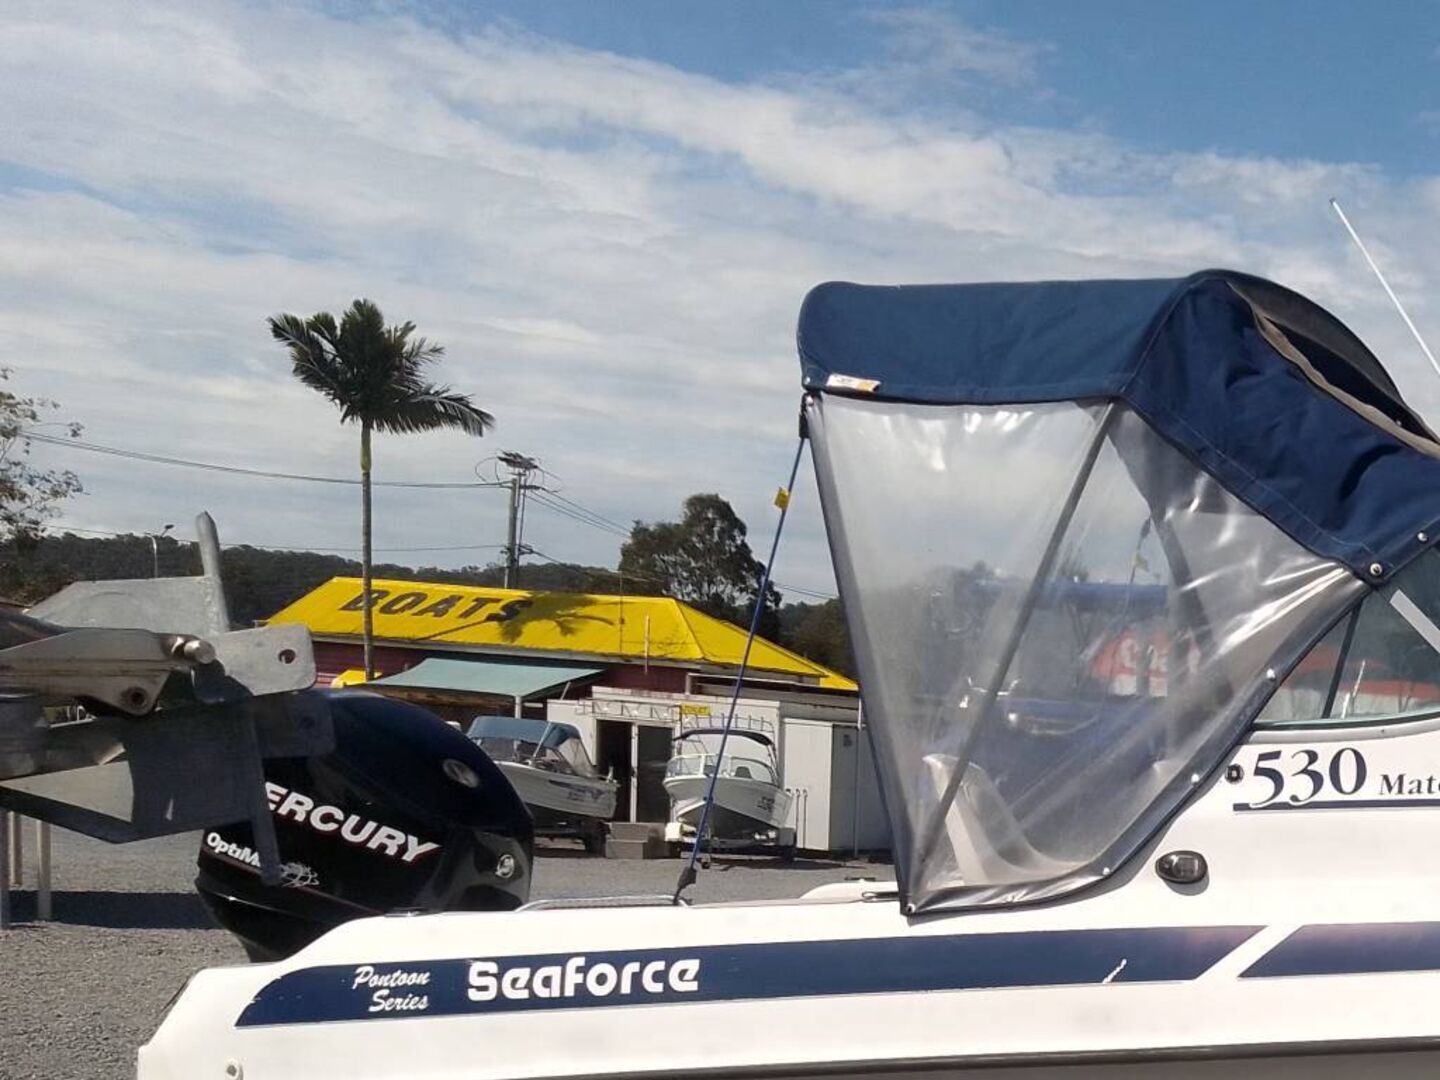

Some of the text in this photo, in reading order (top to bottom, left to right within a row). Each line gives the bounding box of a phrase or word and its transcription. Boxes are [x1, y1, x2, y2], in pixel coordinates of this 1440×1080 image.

[338, 588, 534, 623] BOATS
[1252, 746, 1368, 806] 530
[264, 781, 442, 864] ERCURY
[352, 965, 431, 990] Pontoon
[466, 956, 701, 1002] Seaforce
[367, 988, 430, 1013] Series
